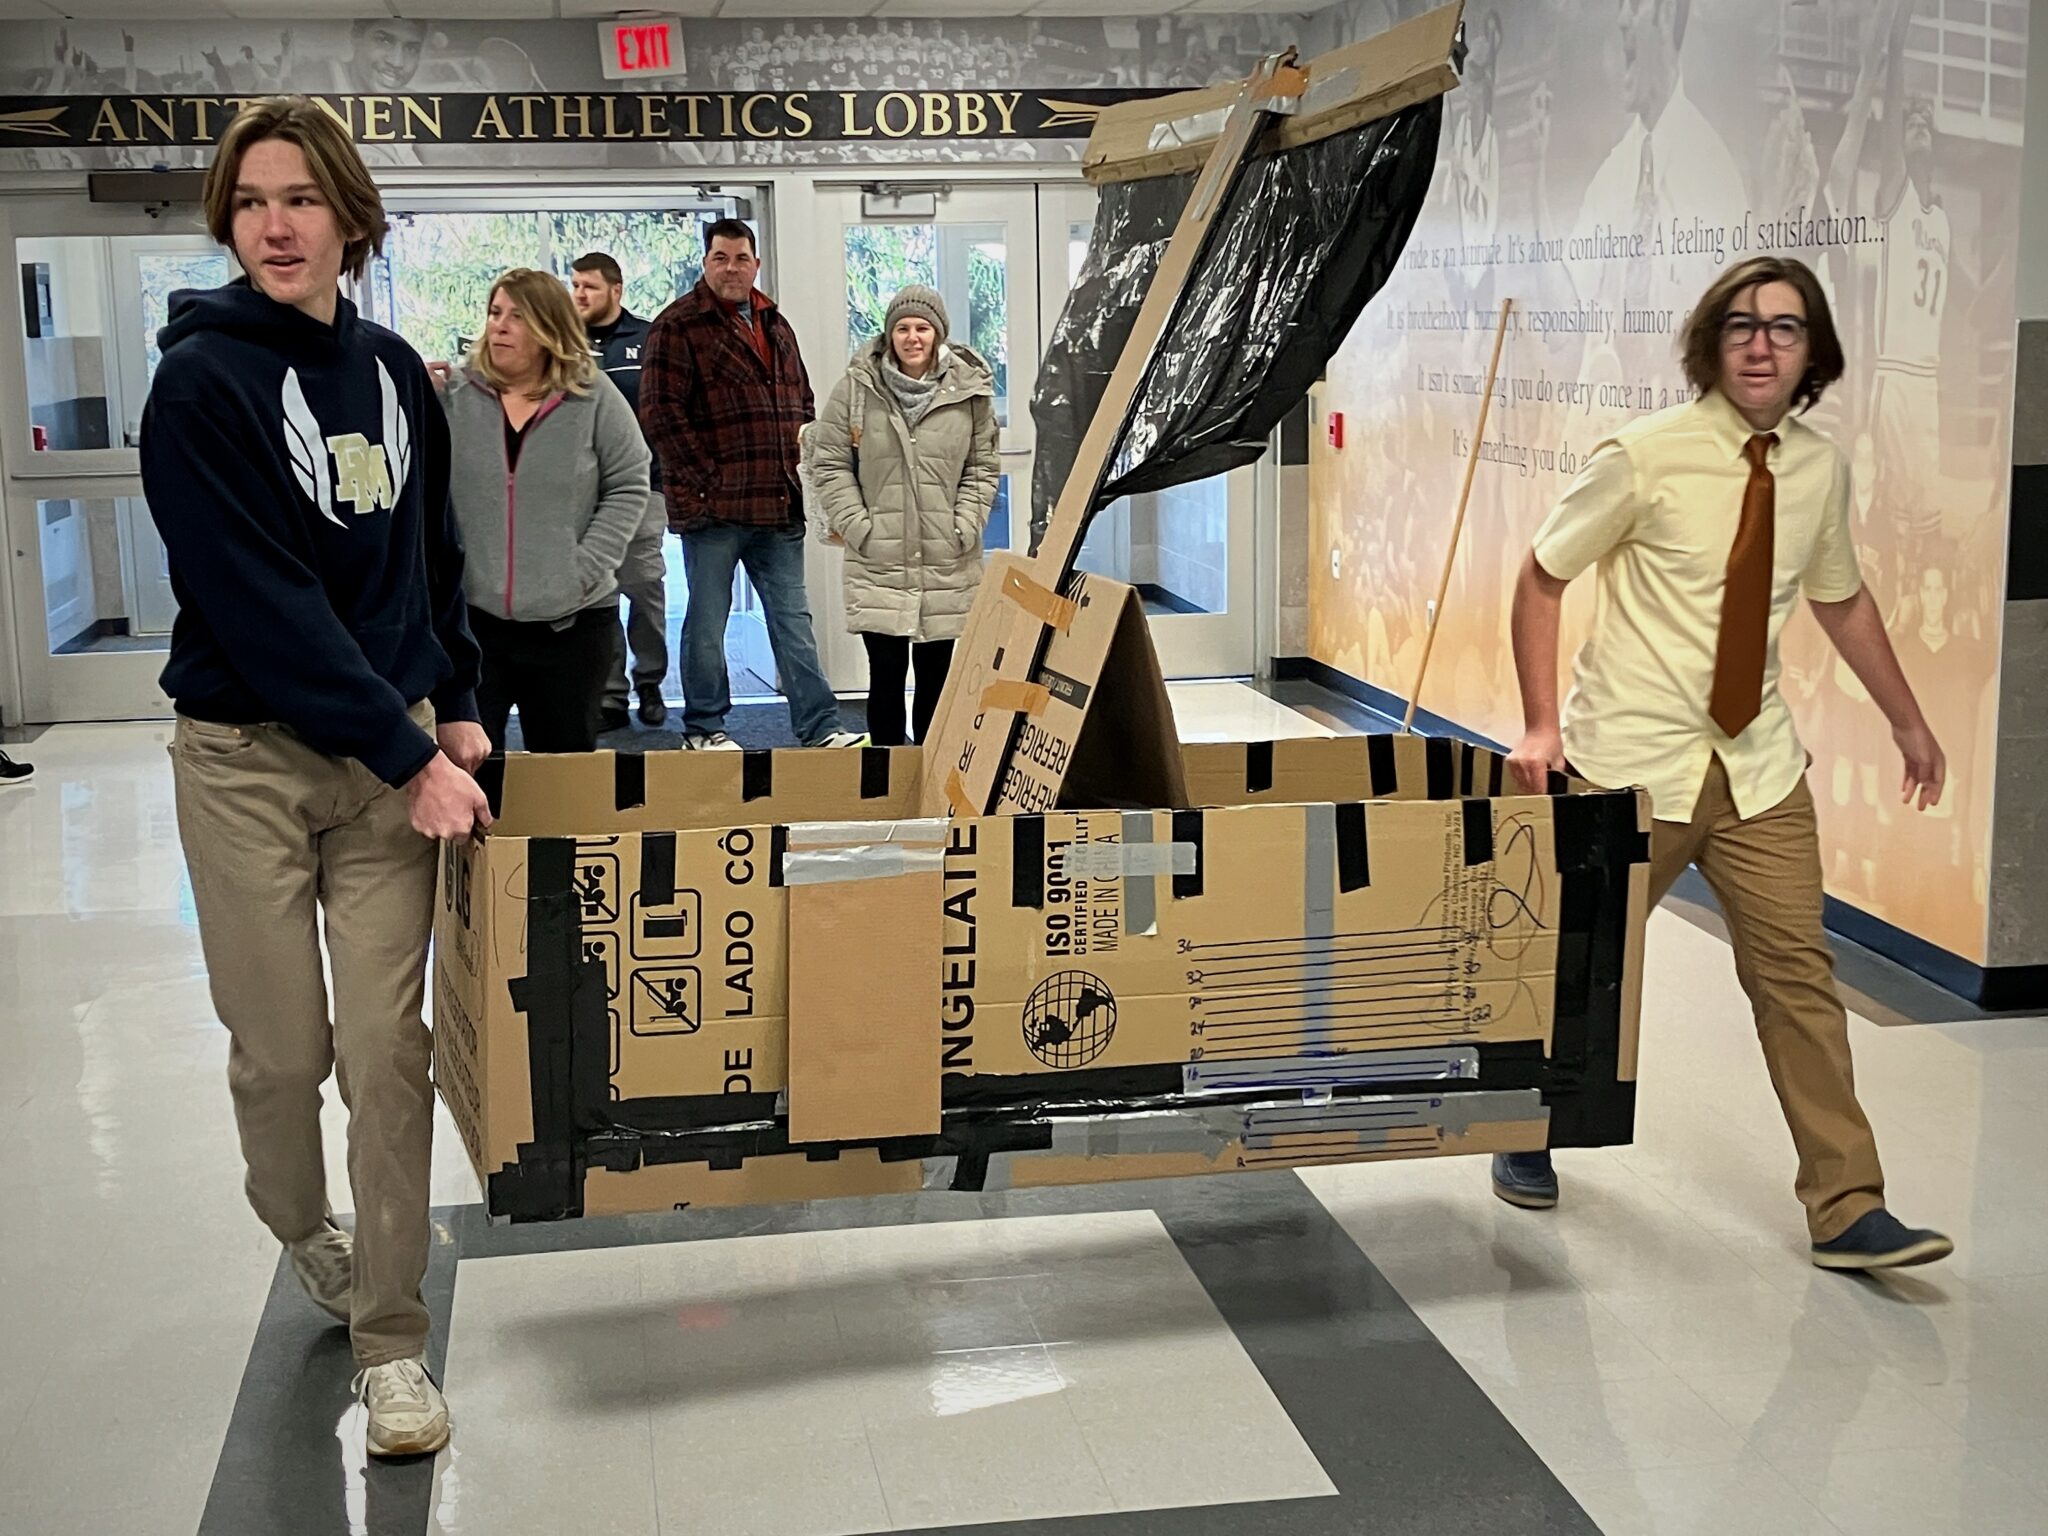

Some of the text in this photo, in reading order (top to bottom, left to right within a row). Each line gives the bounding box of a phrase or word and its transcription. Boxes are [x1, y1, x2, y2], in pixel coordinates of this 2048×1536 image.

[615, 24, 669, 71] EXIT
[87, 92, 1023, 142] ANTTNEN ATHLETICS LOBBY
[1508, 233, 1526, 265] It's
[1529, 229, 1564, 264] about
[1652, 221, 1666, 256] A
[1671, 215, 1725, 265] feeling
[1732, 210, 1752, 252] of
[1757, 205, 1885, 251] satisfaction...
[1913, 258, 1942, 317] 31
[1528, 299, 1618, 344] responsibility,
[625, 345, 641, 361] N
[1452, 365, 1509, 409] somethng
[1512, 378, 1534, 409] you
[1537, 368, 1554, 403] do
[1557, 380, 1595, 416] every
[1600, 382, 1633, 410] once
[1638, 378, 1652, 410] in
[1659, 387, 1668, 410] a
[1452, 429, 1468, 458] It's
[1532, 447, 1555, 479] you
[1560, 440, 1577, 475] do
[1045, 840, 1072, 957] ISO 9001
[1073, 880, 1089, 956] CERTIFIED
[1093, 888, 1119, 903] IN
[941, 824, 978, 1078] NGELATE
[1092, 908, 1119, 952] MADE
[717, 828, 755, 1096] DE LADO CÔ
[1185, 969, 1204, 986] 32
[1190, 1019, 1206, 1036] 24
